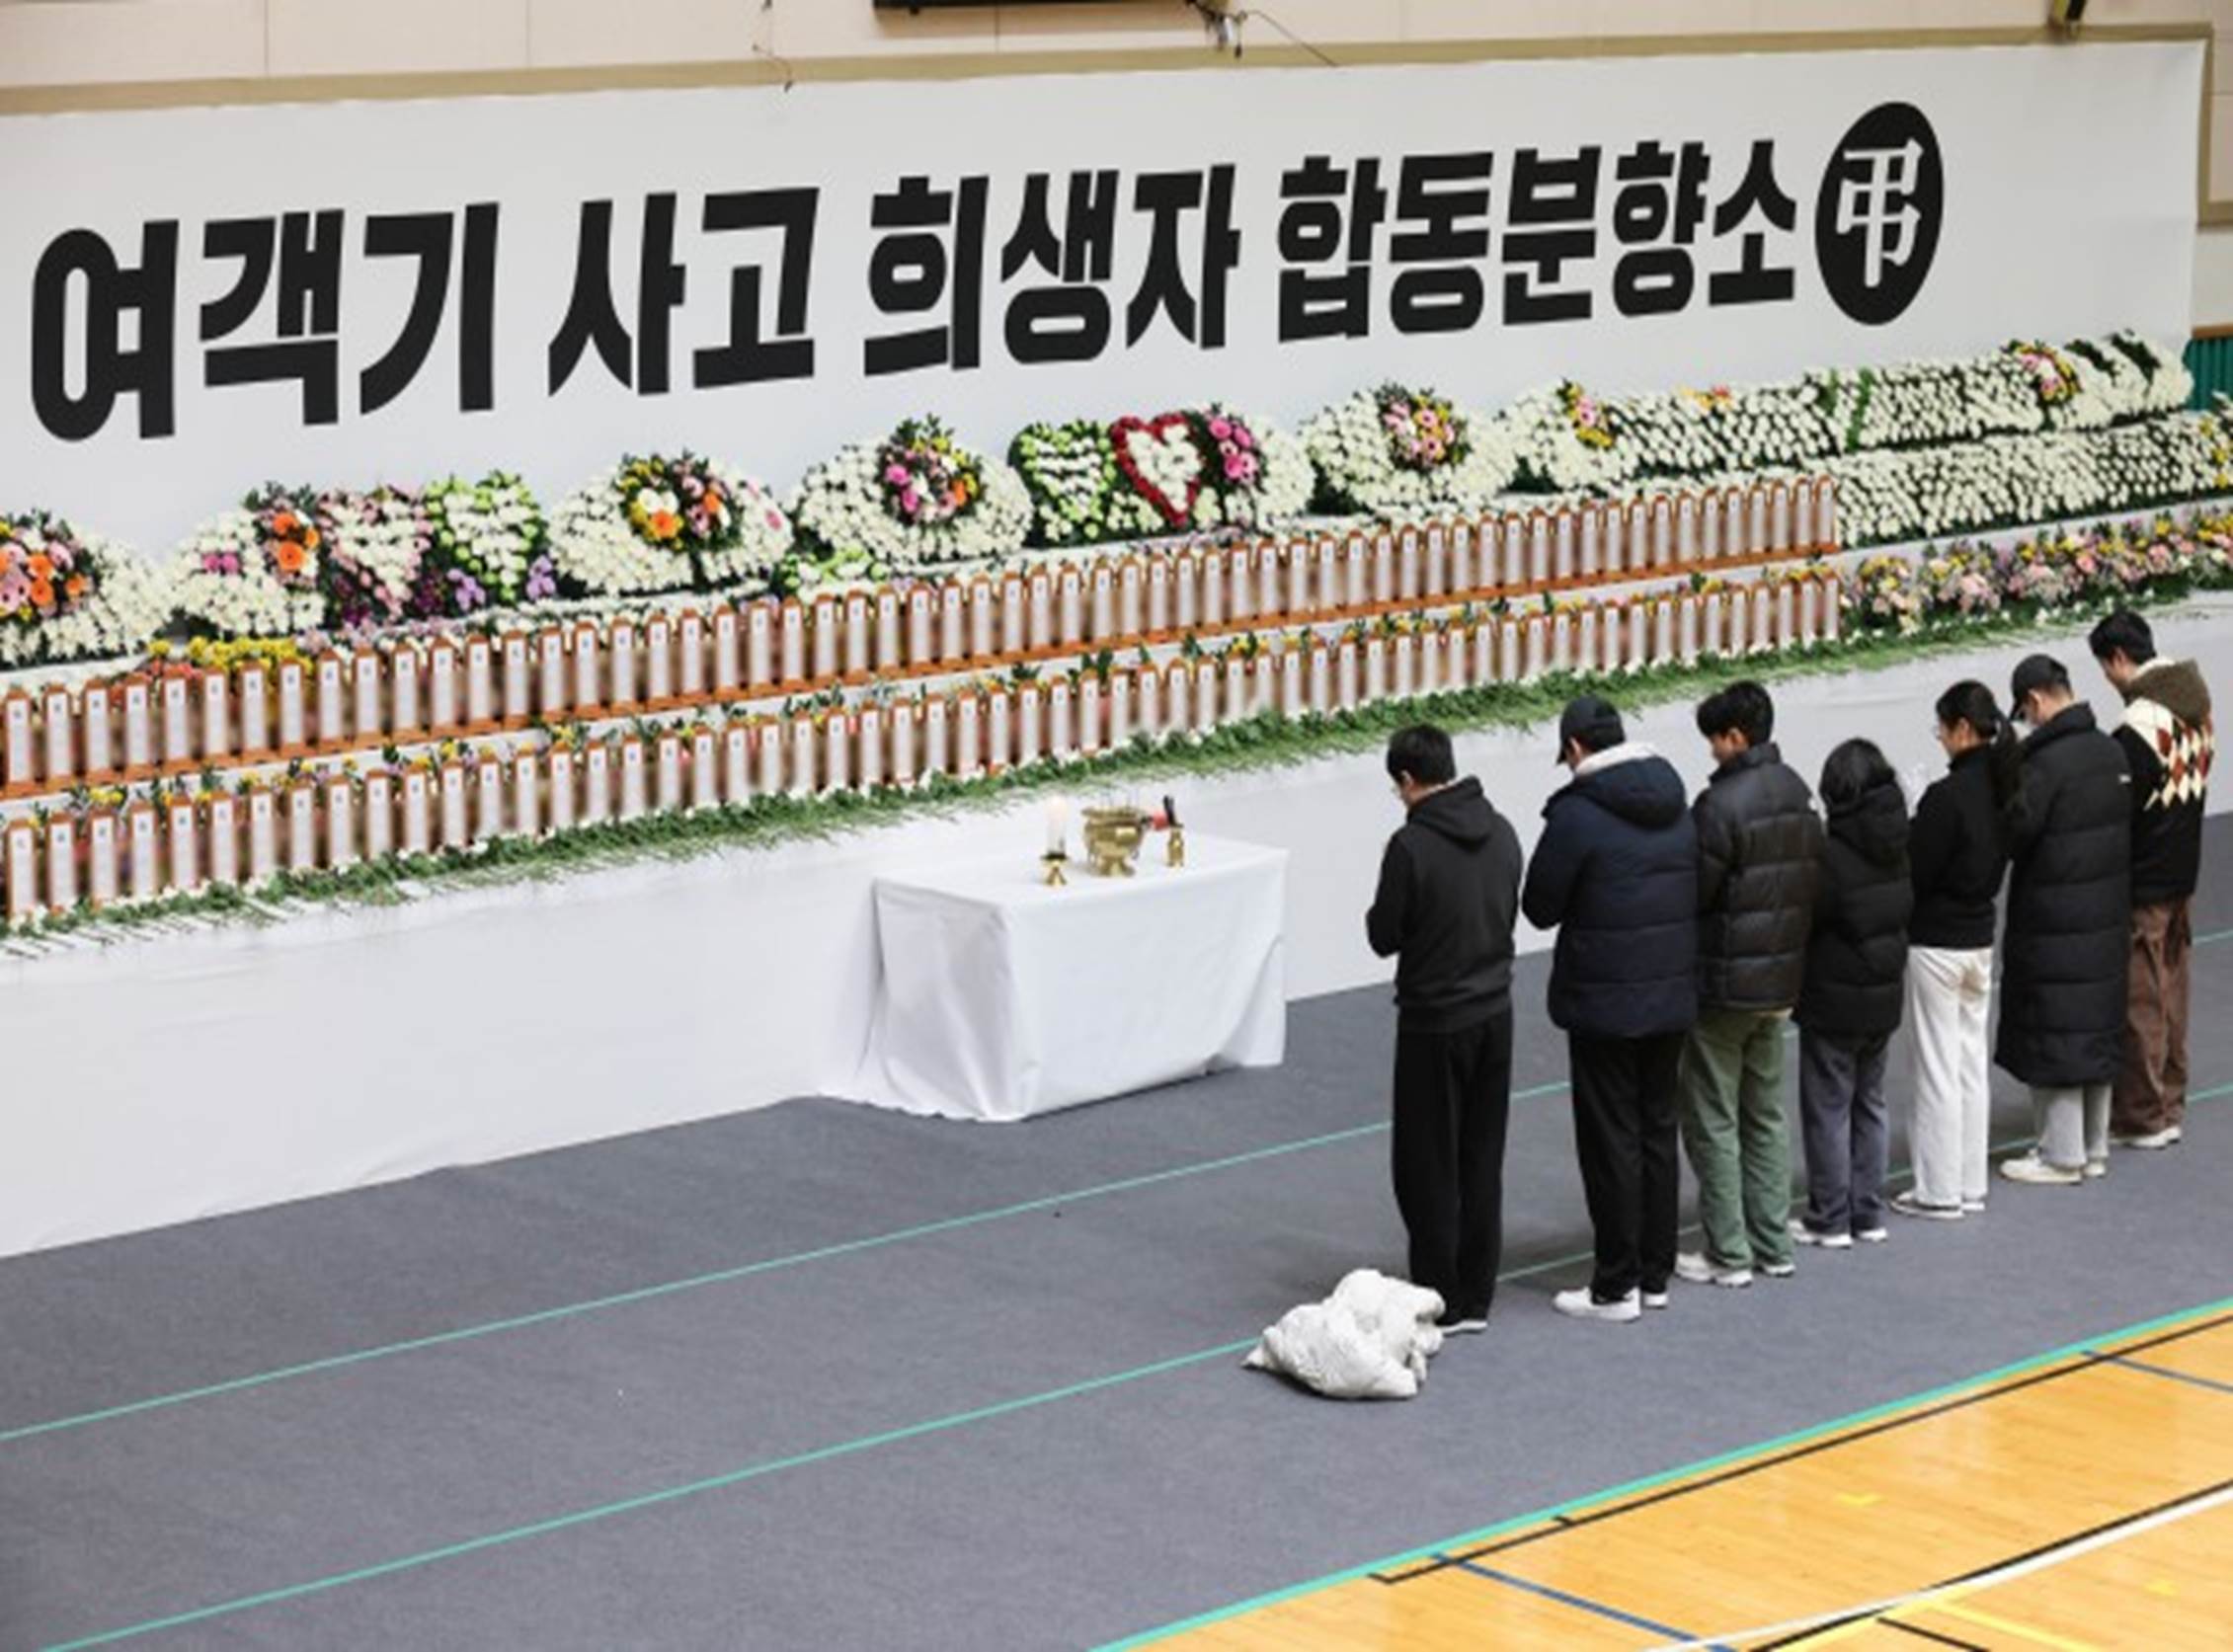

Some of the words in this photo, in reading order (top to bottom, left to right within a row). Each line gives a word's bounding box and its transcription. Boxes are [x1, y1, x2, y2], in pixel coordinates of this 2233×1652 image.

[32, 201, 499, 441] 여객기
[548, 187, 820, 396] 사고
[864, 163, 1241, 376] 희생자
[1277, 139, 1796, 343] 합동분향소
